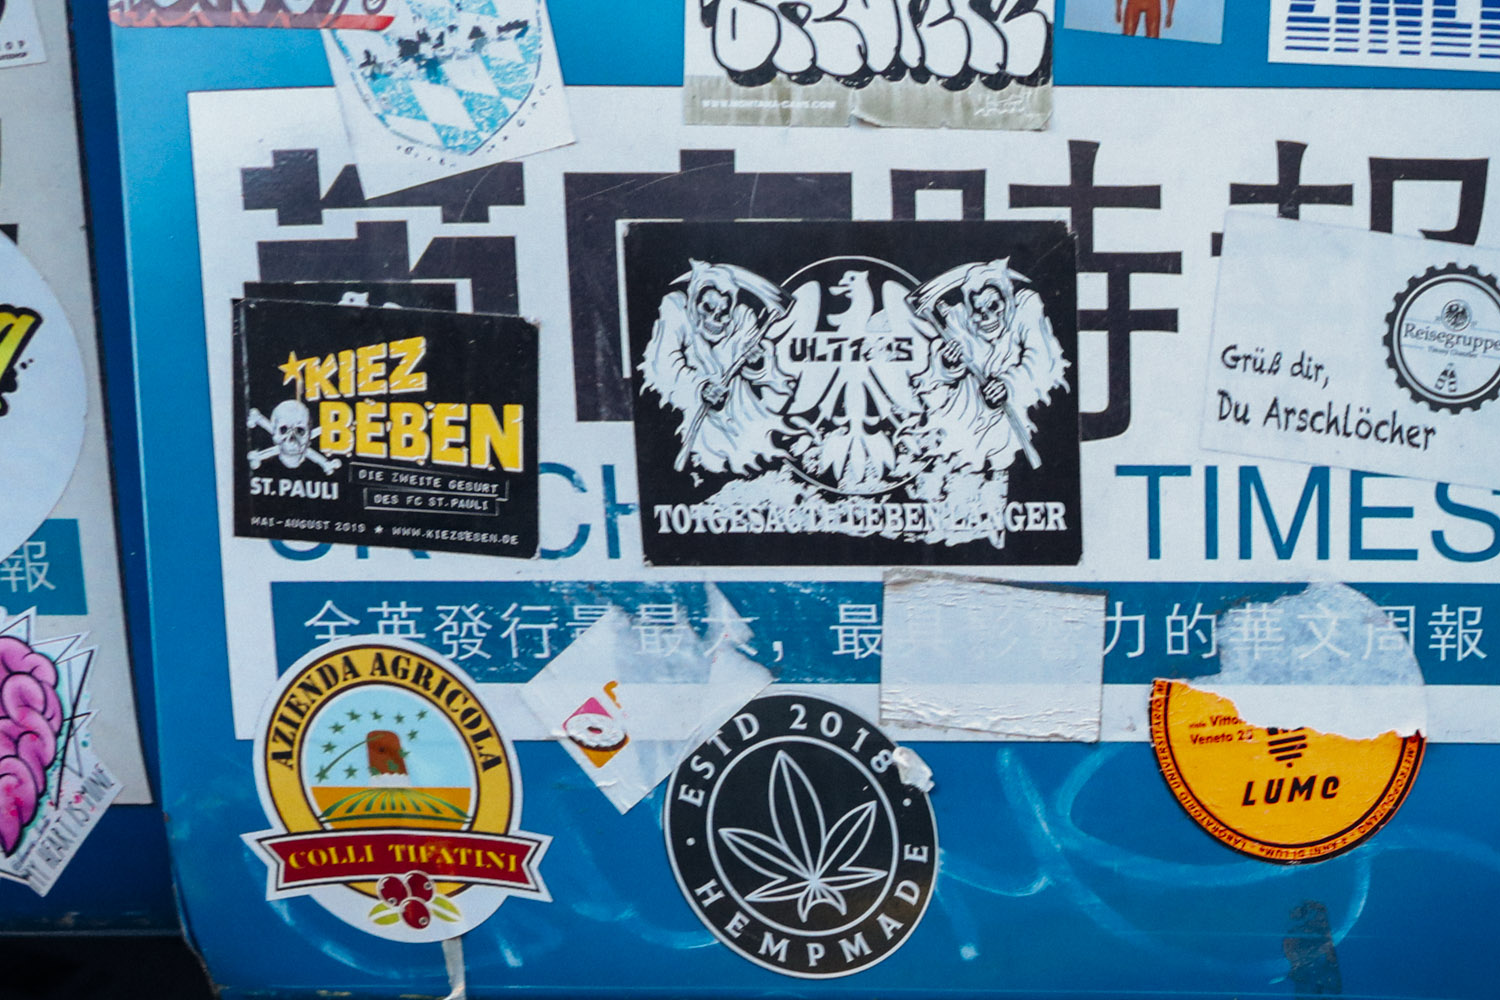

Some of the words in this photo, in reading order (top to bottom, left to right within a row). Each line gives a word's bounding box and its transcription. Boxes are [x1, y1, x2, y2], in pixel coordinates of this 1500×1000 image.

[299, 336, 428, 401] KIEZ
[1221, 344, 1283, 376] Grüß
[1290, 350, 1330, 390] dir,
[319, 400, 524, 473] BEBEN
[1217, 388, 1251, 426] Du
[1263, 395, 1437, 452] Arschlöcher
[358, 470, 384, 481] DIE
[391, 471, 443, 488] ZWEITE
[448, 480, 499, 494] GEBURT
[373, 494, 400, 505] DES
[406, 495, 423, 506] FC
[250, 516, 331, 530] MAI-AUGUST
[335, 520, 367, 533] 2019
[392, 526, 520, 546] WWW.KIEZBEBEN.DE
[269, 653, 362, 772] AZIENDA
[368, 651, 504, 774] AGRICOLA
[1209, 714, 1245, 728] Vitto
[677, 712, 760, 808] ESTD
[788, 703, 896, 775] 2018
[1189, 732, 1234, 746] Veneto
[288, 842, 376, 870] COLLI
[388, 842, 520, 874] TIFATINI
[694, 843, 930, 967] HEMPMADE
